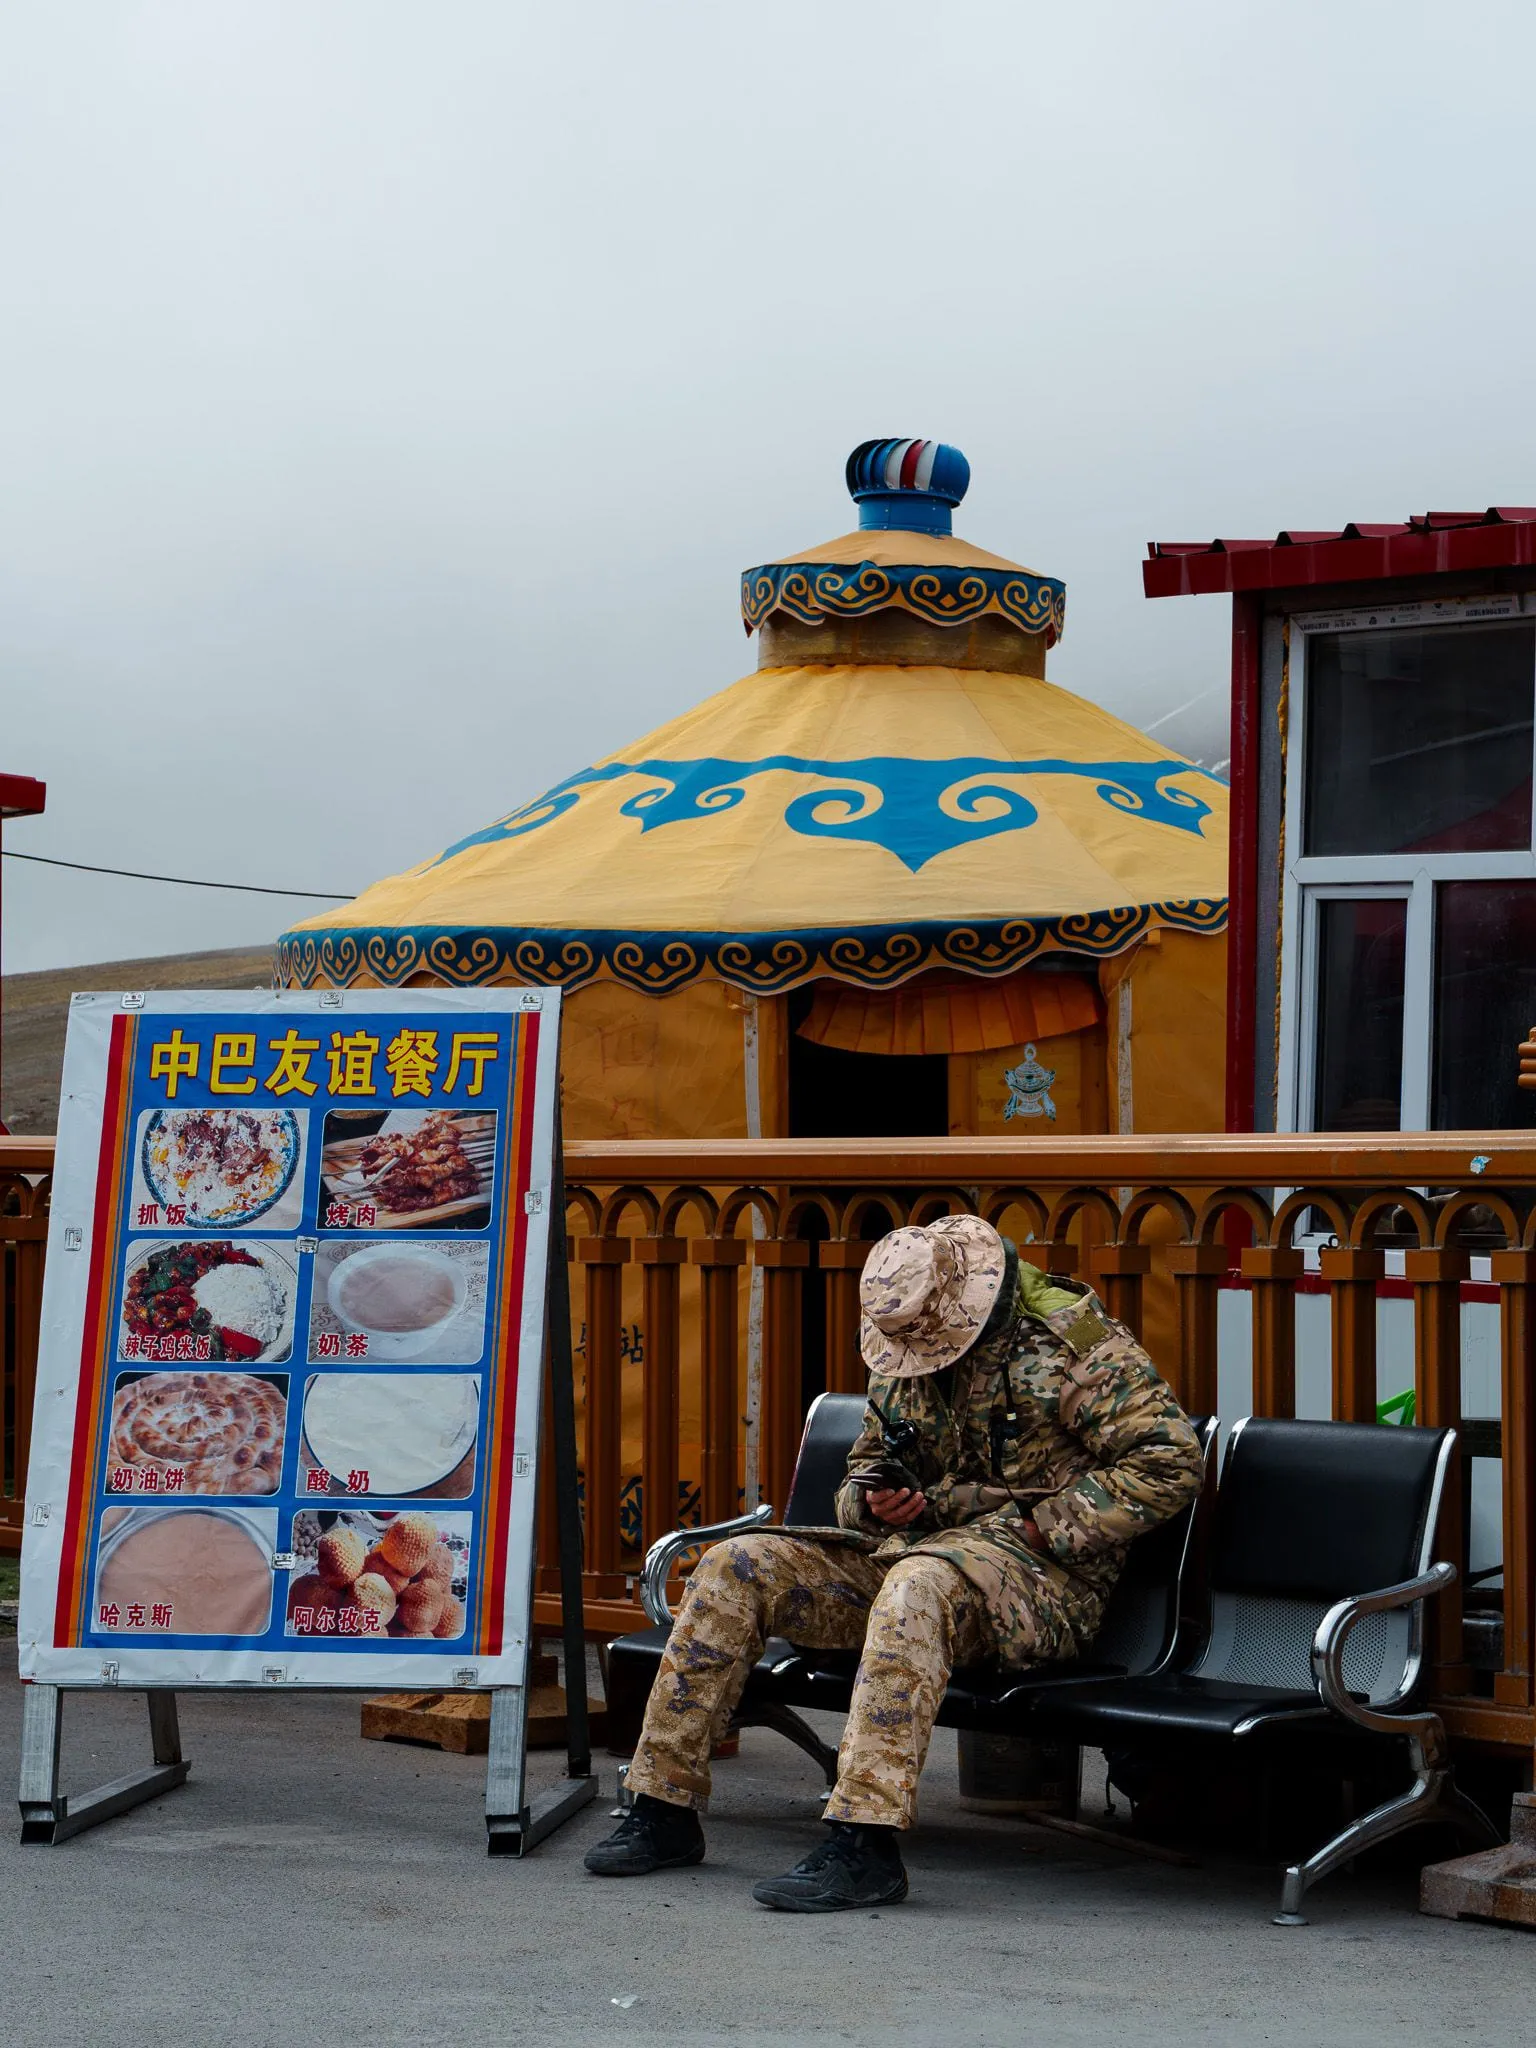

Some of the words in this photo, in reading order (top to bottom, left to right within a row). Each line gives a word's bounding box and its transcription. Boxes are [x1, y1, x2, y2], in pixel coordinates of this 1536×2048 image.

[149, 1029, 500, 1098] 中巴友谊餐厅
[137, 1203, 187, 1226] 抓饭
[325, 1203, 377, 1227] 烤肉
[124, 1335, 211, 1359] 辣子鸡米饭
[317, 1333, 370, 1357] 奶茶
[112, 1468, 186, 1492] 奶油饼
[306, 1468, 370, 1493] 酸奶
[98, 1602, 174, 1628] 哈克斯
[292, 1606, 382, 1632] 阿尔孜克
